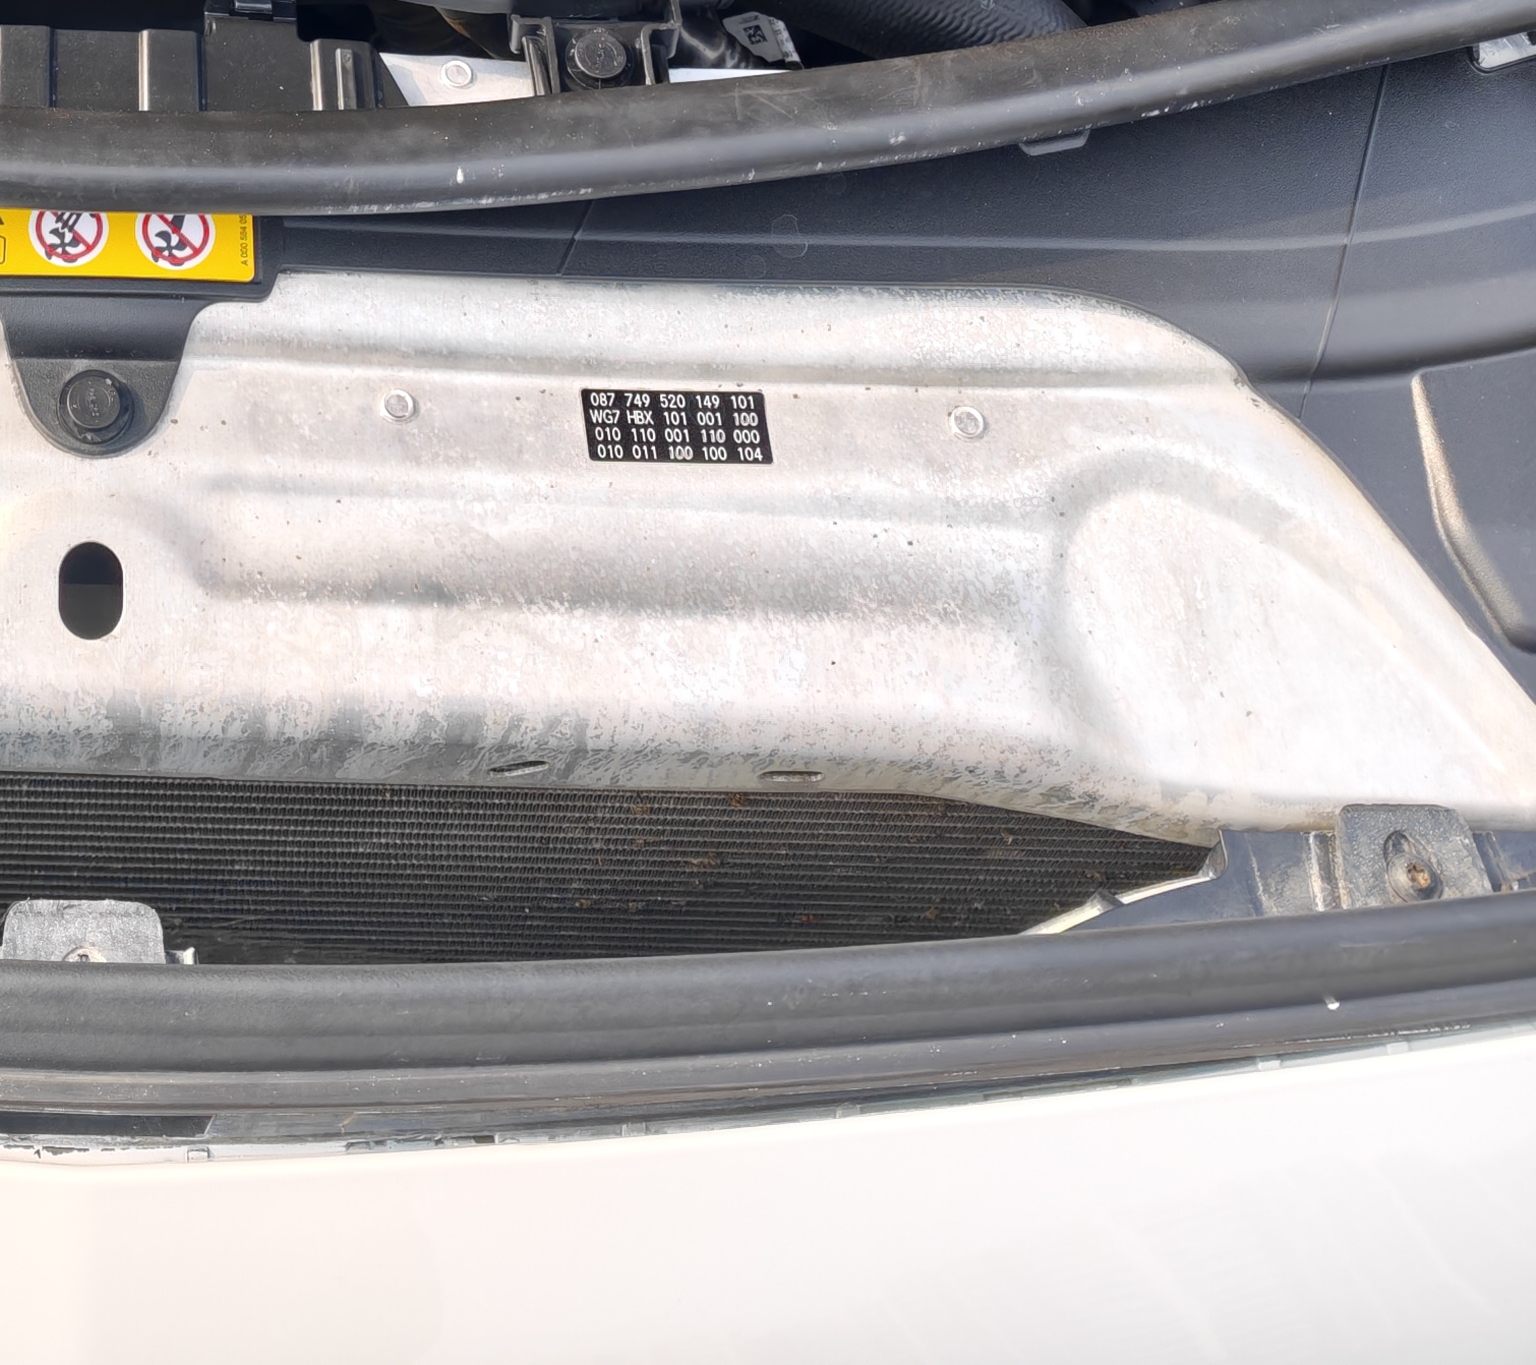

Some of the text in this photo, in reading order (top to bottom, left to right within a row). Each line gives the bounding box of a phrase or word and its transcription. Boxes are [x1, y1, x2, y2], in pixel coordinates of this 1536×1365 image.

[590, 392, 755, 410] 087 749 520 149 101
[589, 409, 759, 427] WG7 HBX 101 001 100
[595, 427, 760, 444] 010 110 001 110 000
[597, 444, 763, 462] 010 011 100 100 104
